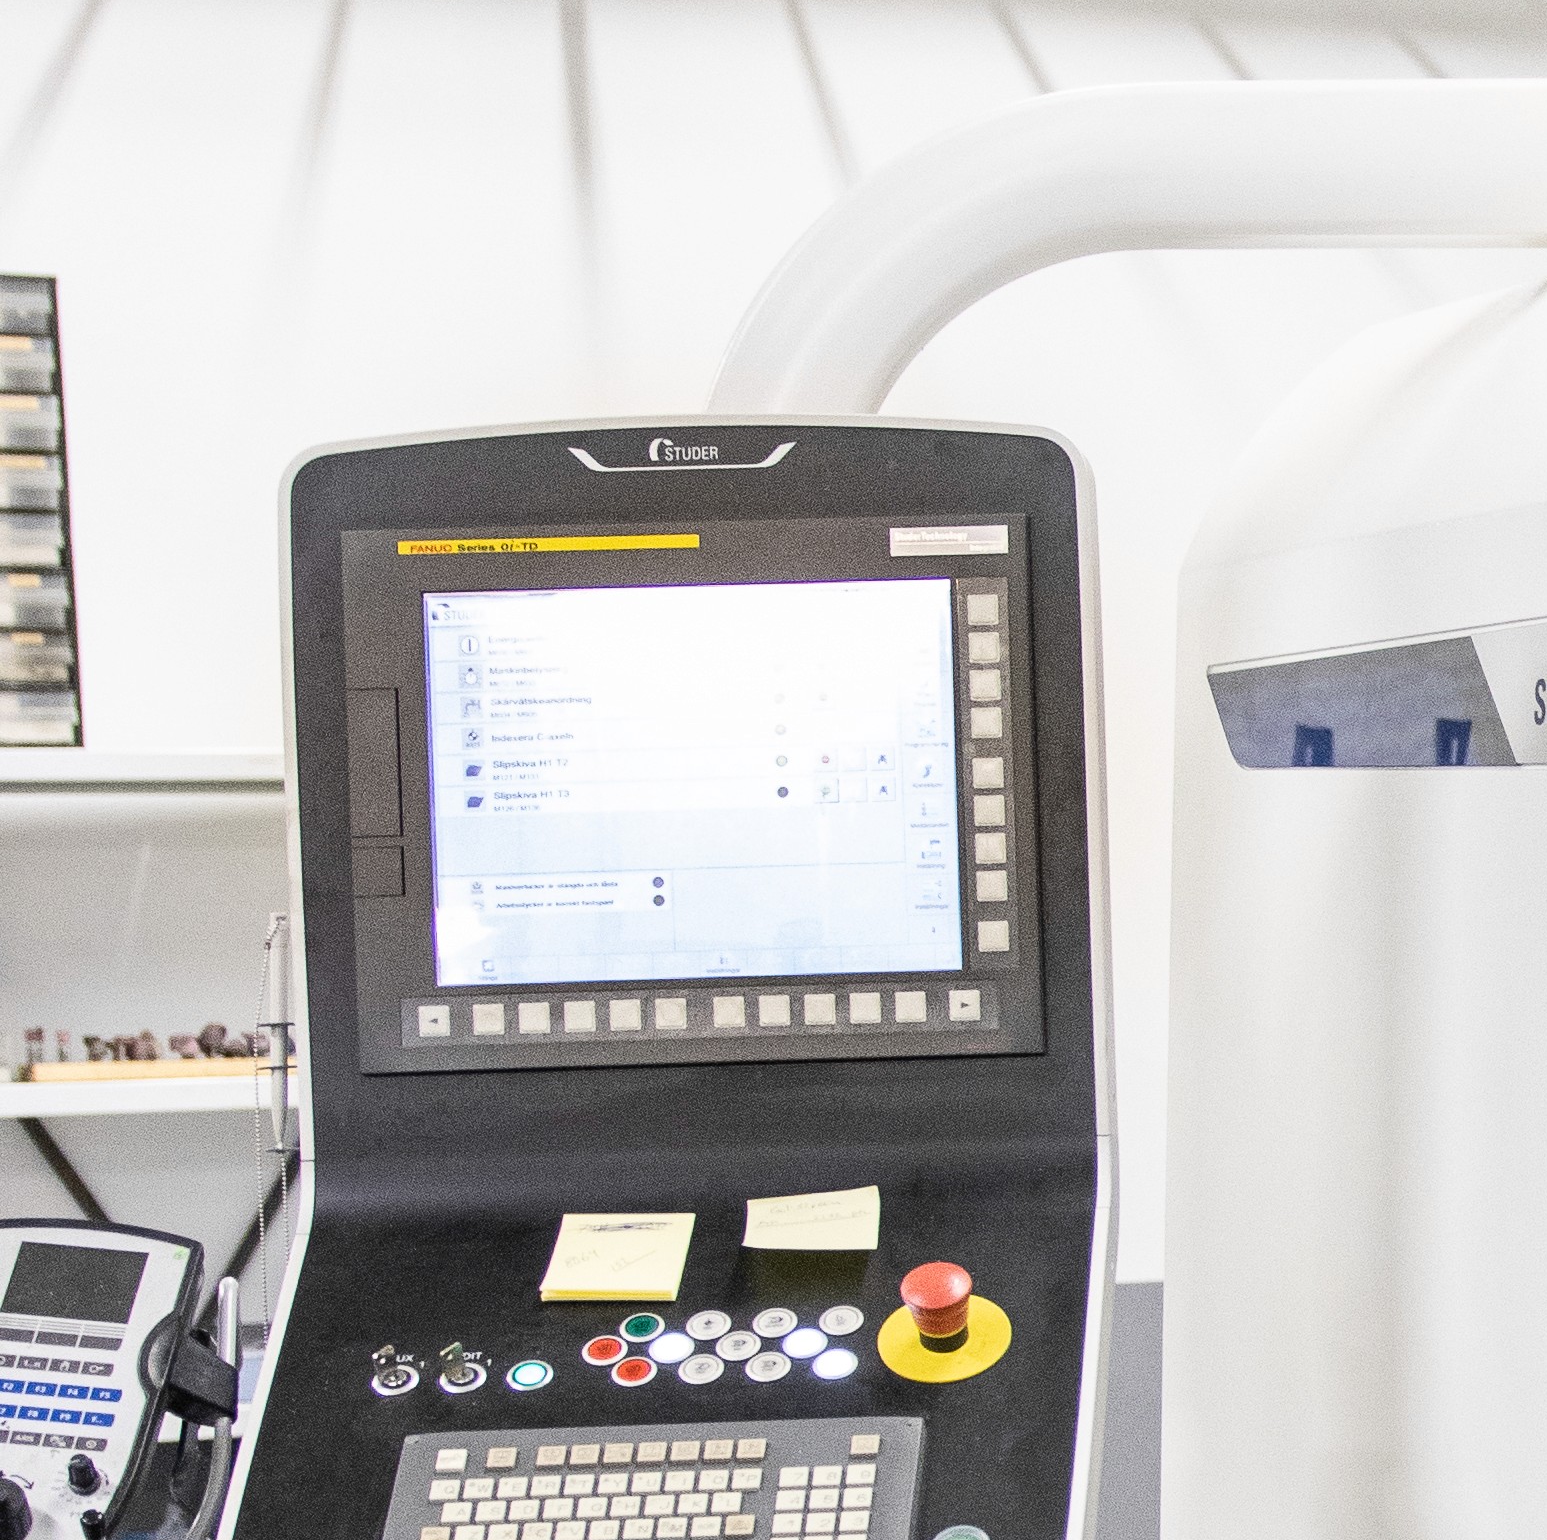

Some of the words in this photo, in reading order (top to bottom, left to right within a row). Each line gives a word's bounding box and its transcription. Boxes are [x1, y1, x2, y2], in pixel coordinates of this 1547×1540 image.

[665, 446, 719, 461] STUDER
[410, 544, 452, 554] FANUC
[457, 542, 495, 553] Series
[492, 760, 537, 770] Slipskiva
[494, 791, 538, 801] Slipskiva
